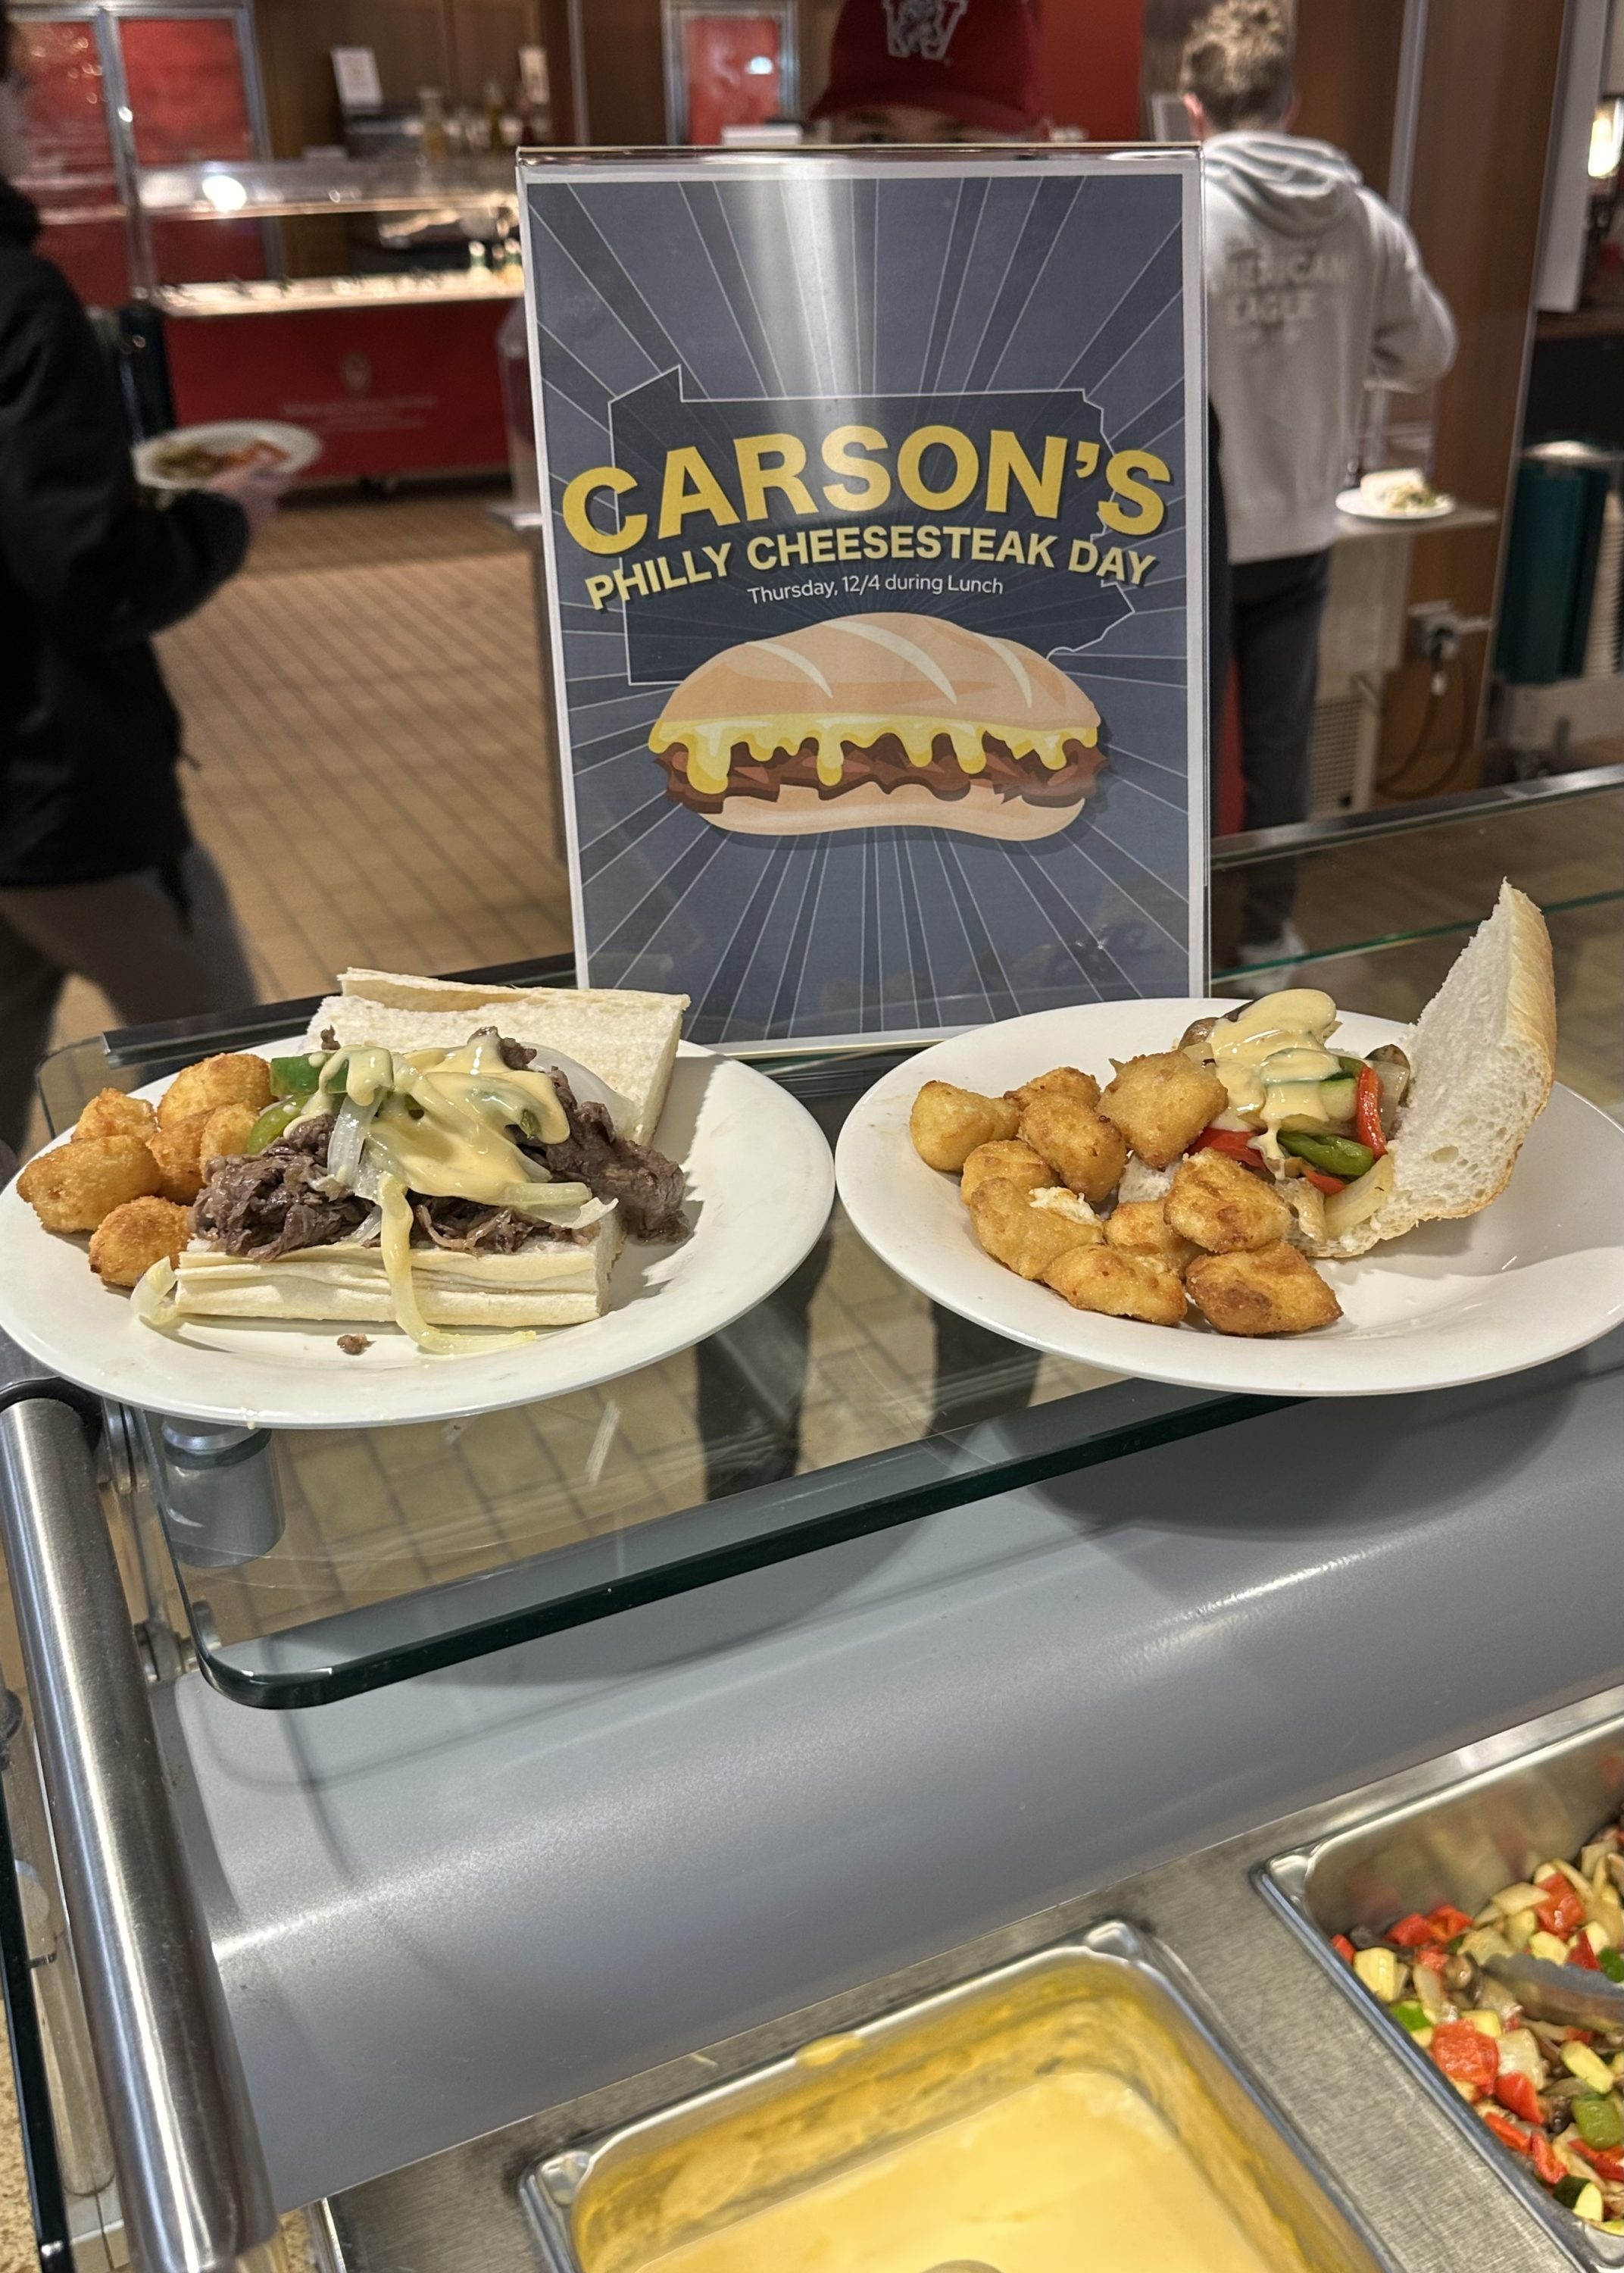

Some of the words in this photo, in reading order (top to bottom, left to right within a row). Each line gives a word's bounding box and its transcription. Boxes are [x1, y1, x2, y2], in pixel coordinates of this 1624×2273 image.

[562, 425, 1171, 555] CARSON'S
[585, 542, 732, 610] PHILLY
[747, 525, 1058, 571] CHEESESTEAK
[1068, 539, 1157, 586] DAY
[748, 578, 839, 605] Thursday,
[842, 574, 880, 596] 12/4
[885, 574, 943, 593] during
[947, 574, 1004, 595] Lunch
